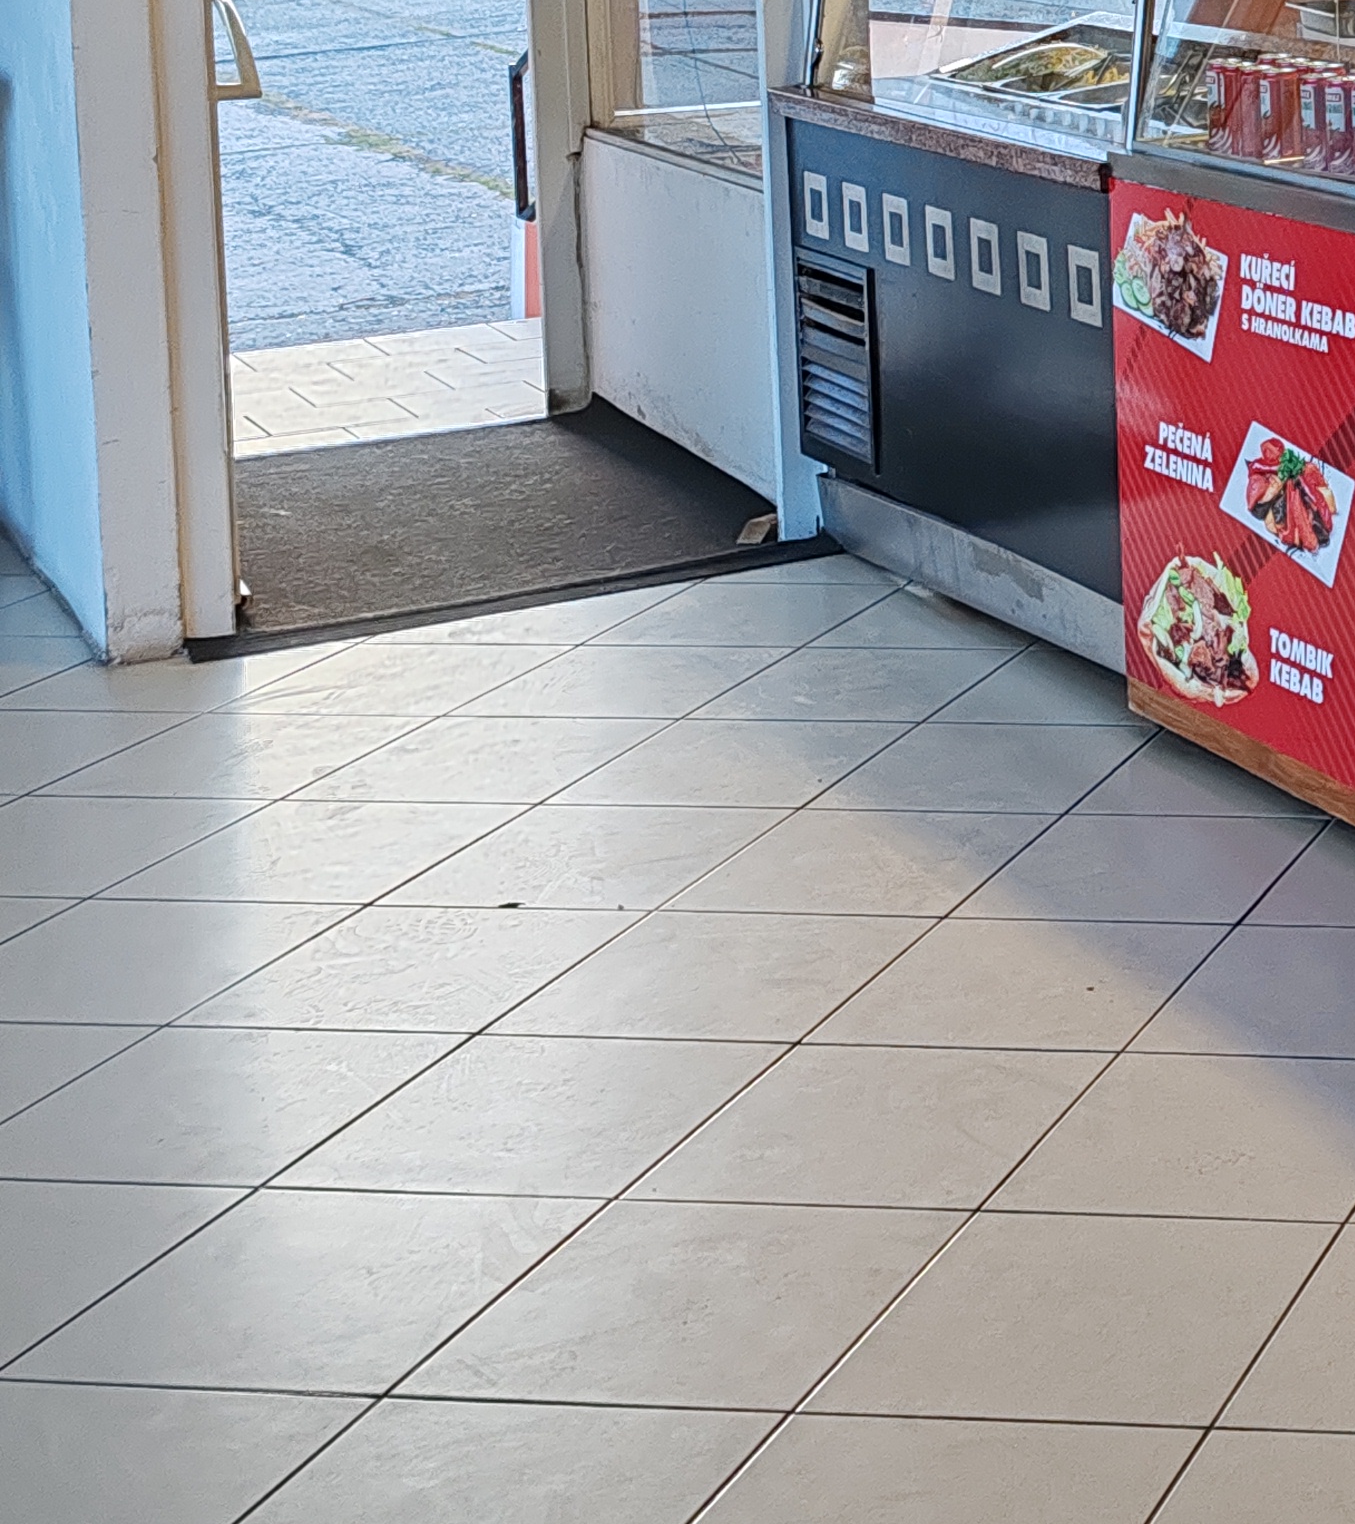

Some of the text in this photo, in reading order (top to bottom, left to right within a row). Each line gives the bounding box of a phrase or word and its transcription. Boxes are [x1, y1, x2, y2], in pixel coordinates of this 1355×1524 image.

[1240, 253, 1296, 291] KUŘECÍ
[1241, 282, 1297, 323] DÖNER
[1241, 313, 1329, 353] S HRANOLKAMA
[1158, 421, 1213, 463] PEČENÁ
[1143, 444, 1214, 493] ZELENINA
[1269, 627, 1334, 679] TOMBIK
[1269, 658, 1324, 704] KEBAB
